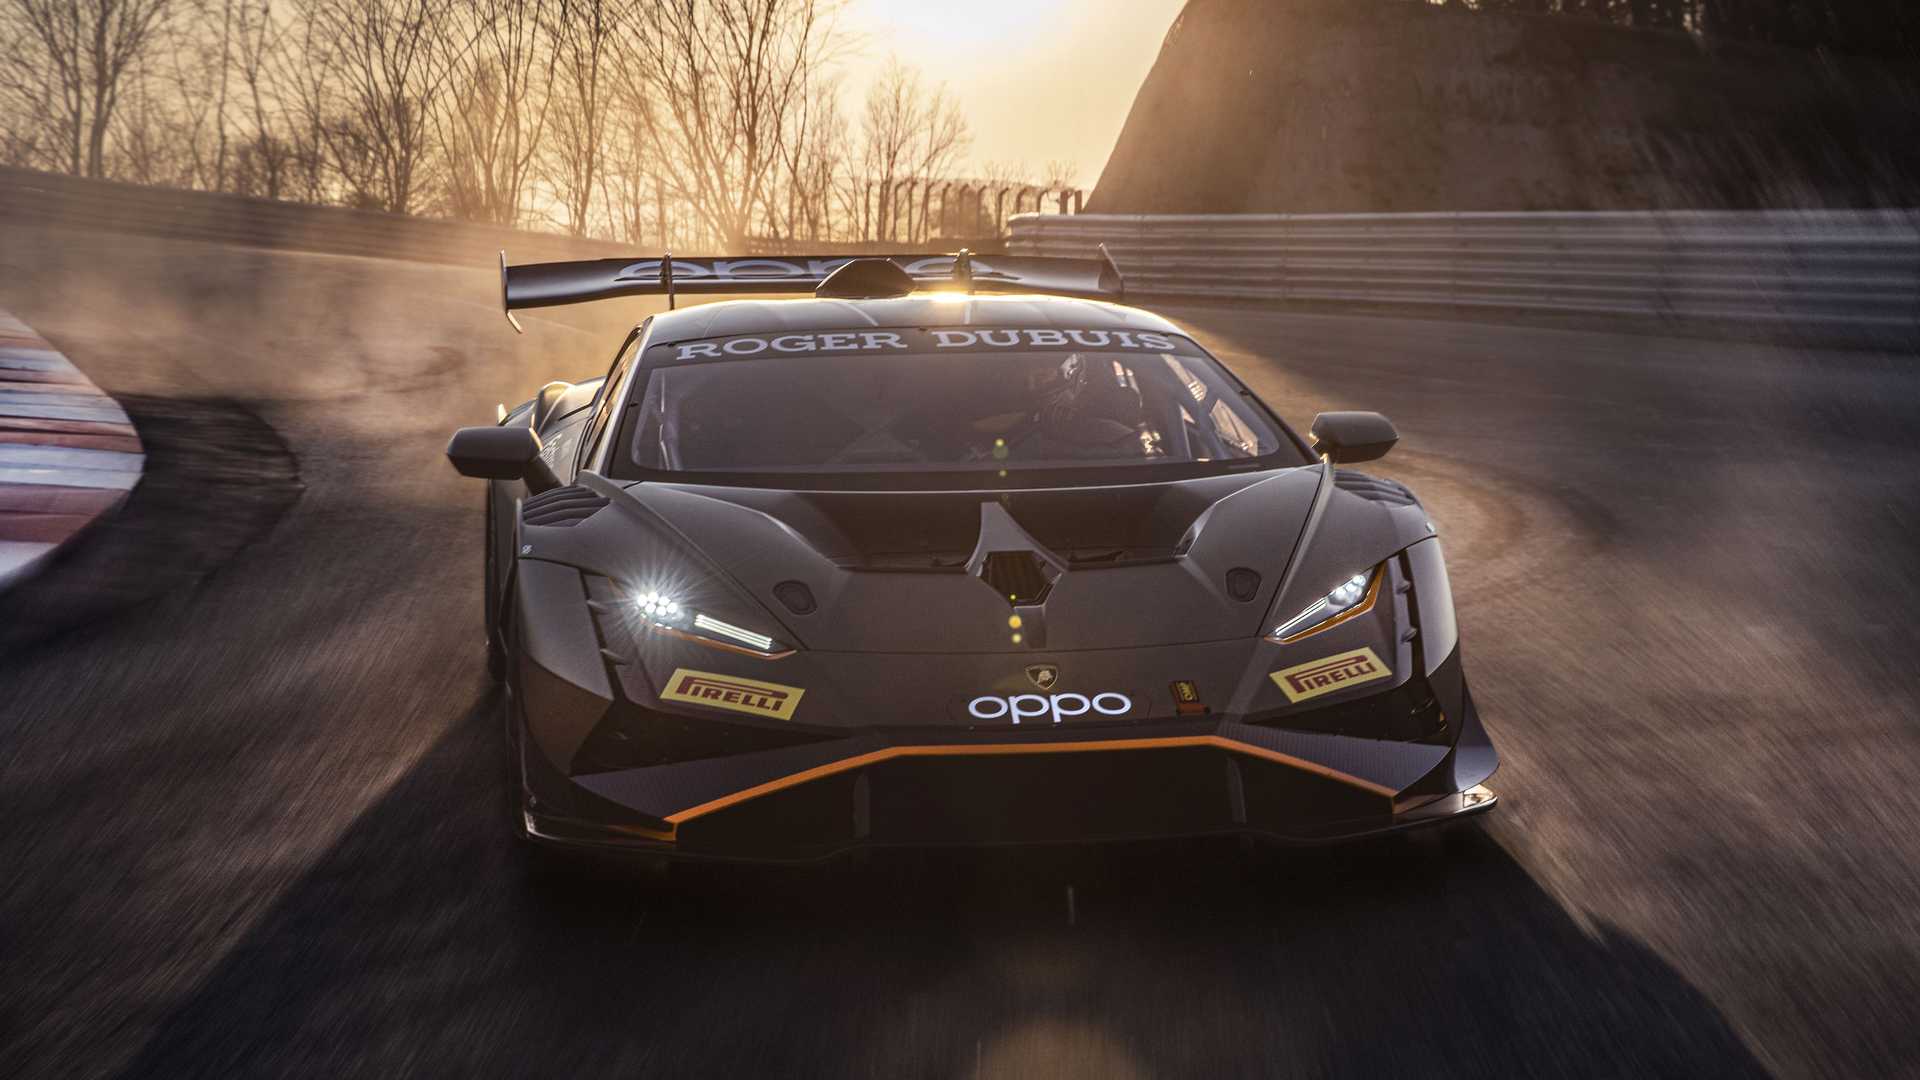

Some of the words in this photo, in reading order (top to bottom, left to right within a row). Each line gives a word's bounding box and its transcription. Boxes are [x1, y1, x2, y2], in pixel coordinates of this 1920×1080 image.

[675, 331, 909, 361] ROGER
[931, 328, 1176, 351] DUBUIS
[1284, 654, 1378, 694] PIRELLI
[675, 675, 790, 712] PIRELLI
[968, 692, 1132, 724] oppo
